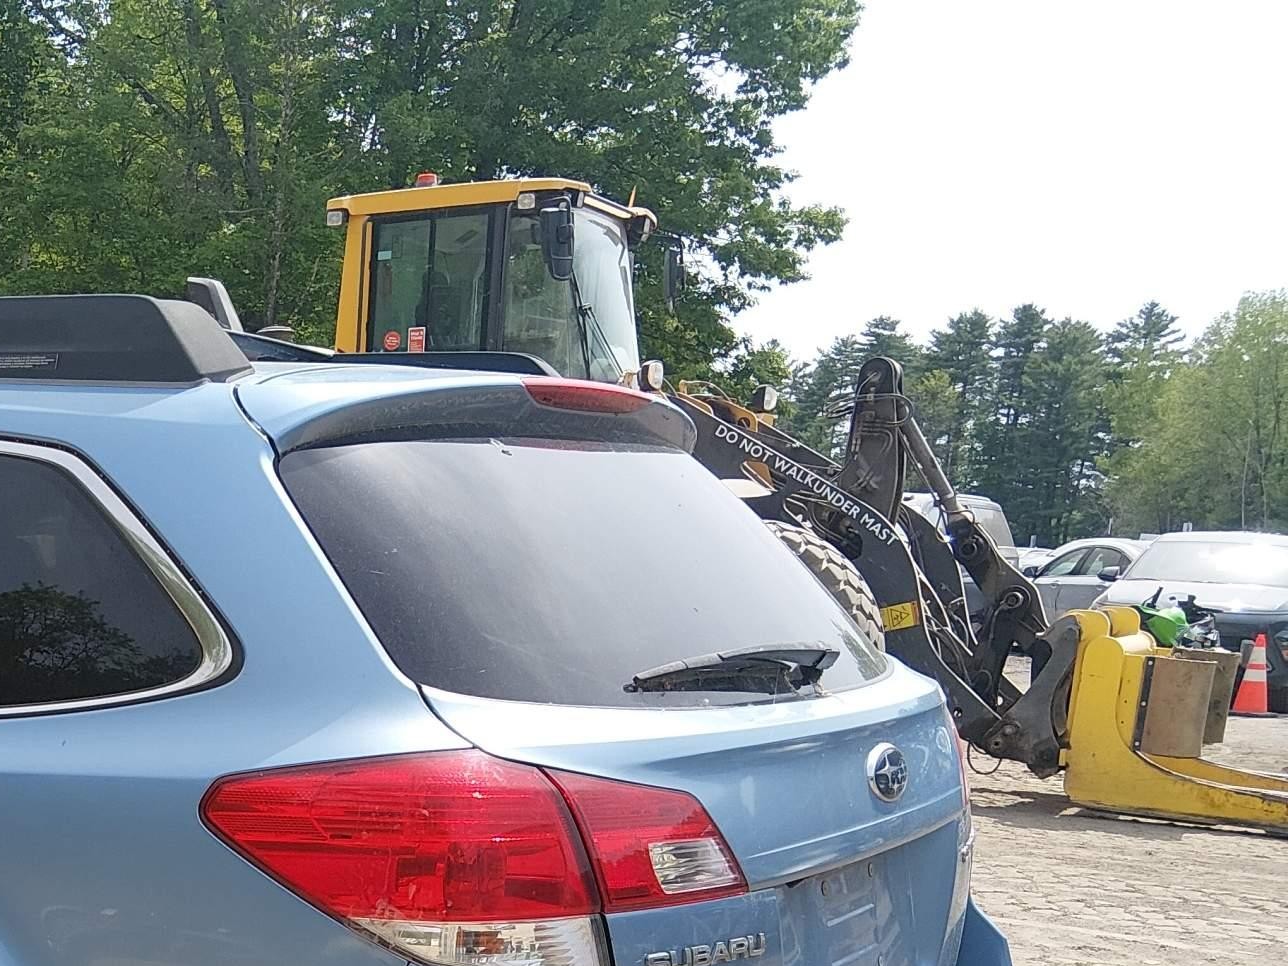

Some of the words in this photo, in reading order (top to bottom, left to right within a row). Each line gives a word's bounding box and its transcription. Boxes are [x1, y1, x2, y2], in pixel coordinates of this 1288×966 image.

[715, 425, 738, 444] DO
[739, 437, 773, 465] NOT
[774, 457, 817, 488] WALK
[813, 475, 860, 518] UNDER
[860, 513, 900, 546] MAST
